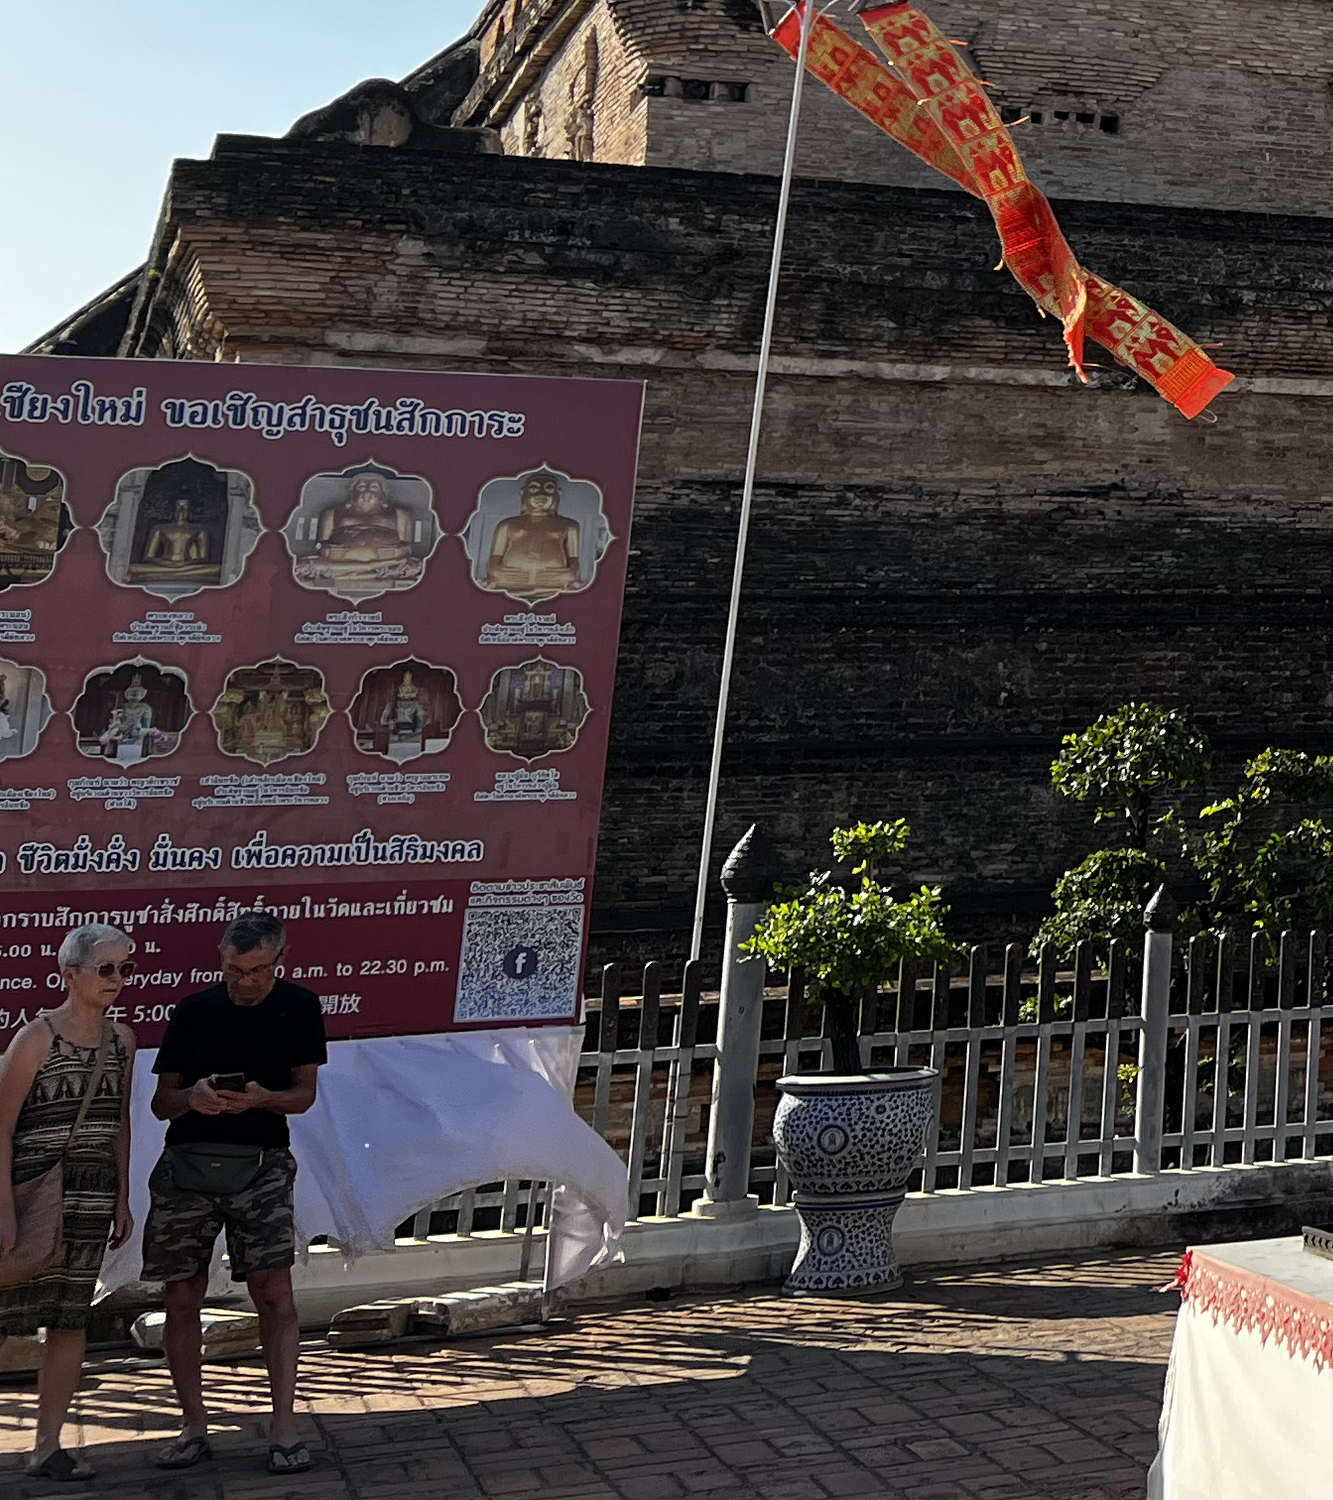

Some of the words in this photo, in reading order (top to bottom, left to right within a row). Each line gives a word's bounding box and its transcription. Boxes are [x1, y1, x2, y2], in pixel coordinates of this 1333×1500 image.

[162, 391, 525, 447] ขอเชิญสาธุชนสักการะ
[17, 835, 140, 873] ชีวิตมั่งคั่ง
[149, 834, 221, 871] มั่นคง
[231, 829, 484, 869] เพื่อความเป็นสิริมงคล
[124, 969, 183, 989] eryday
[292, 966, 328, 979] a.m.
[336, 962, 353, 977] to
[360, 959, 407, 975] 22.30
[414, 960, 450, 977] p.m.
